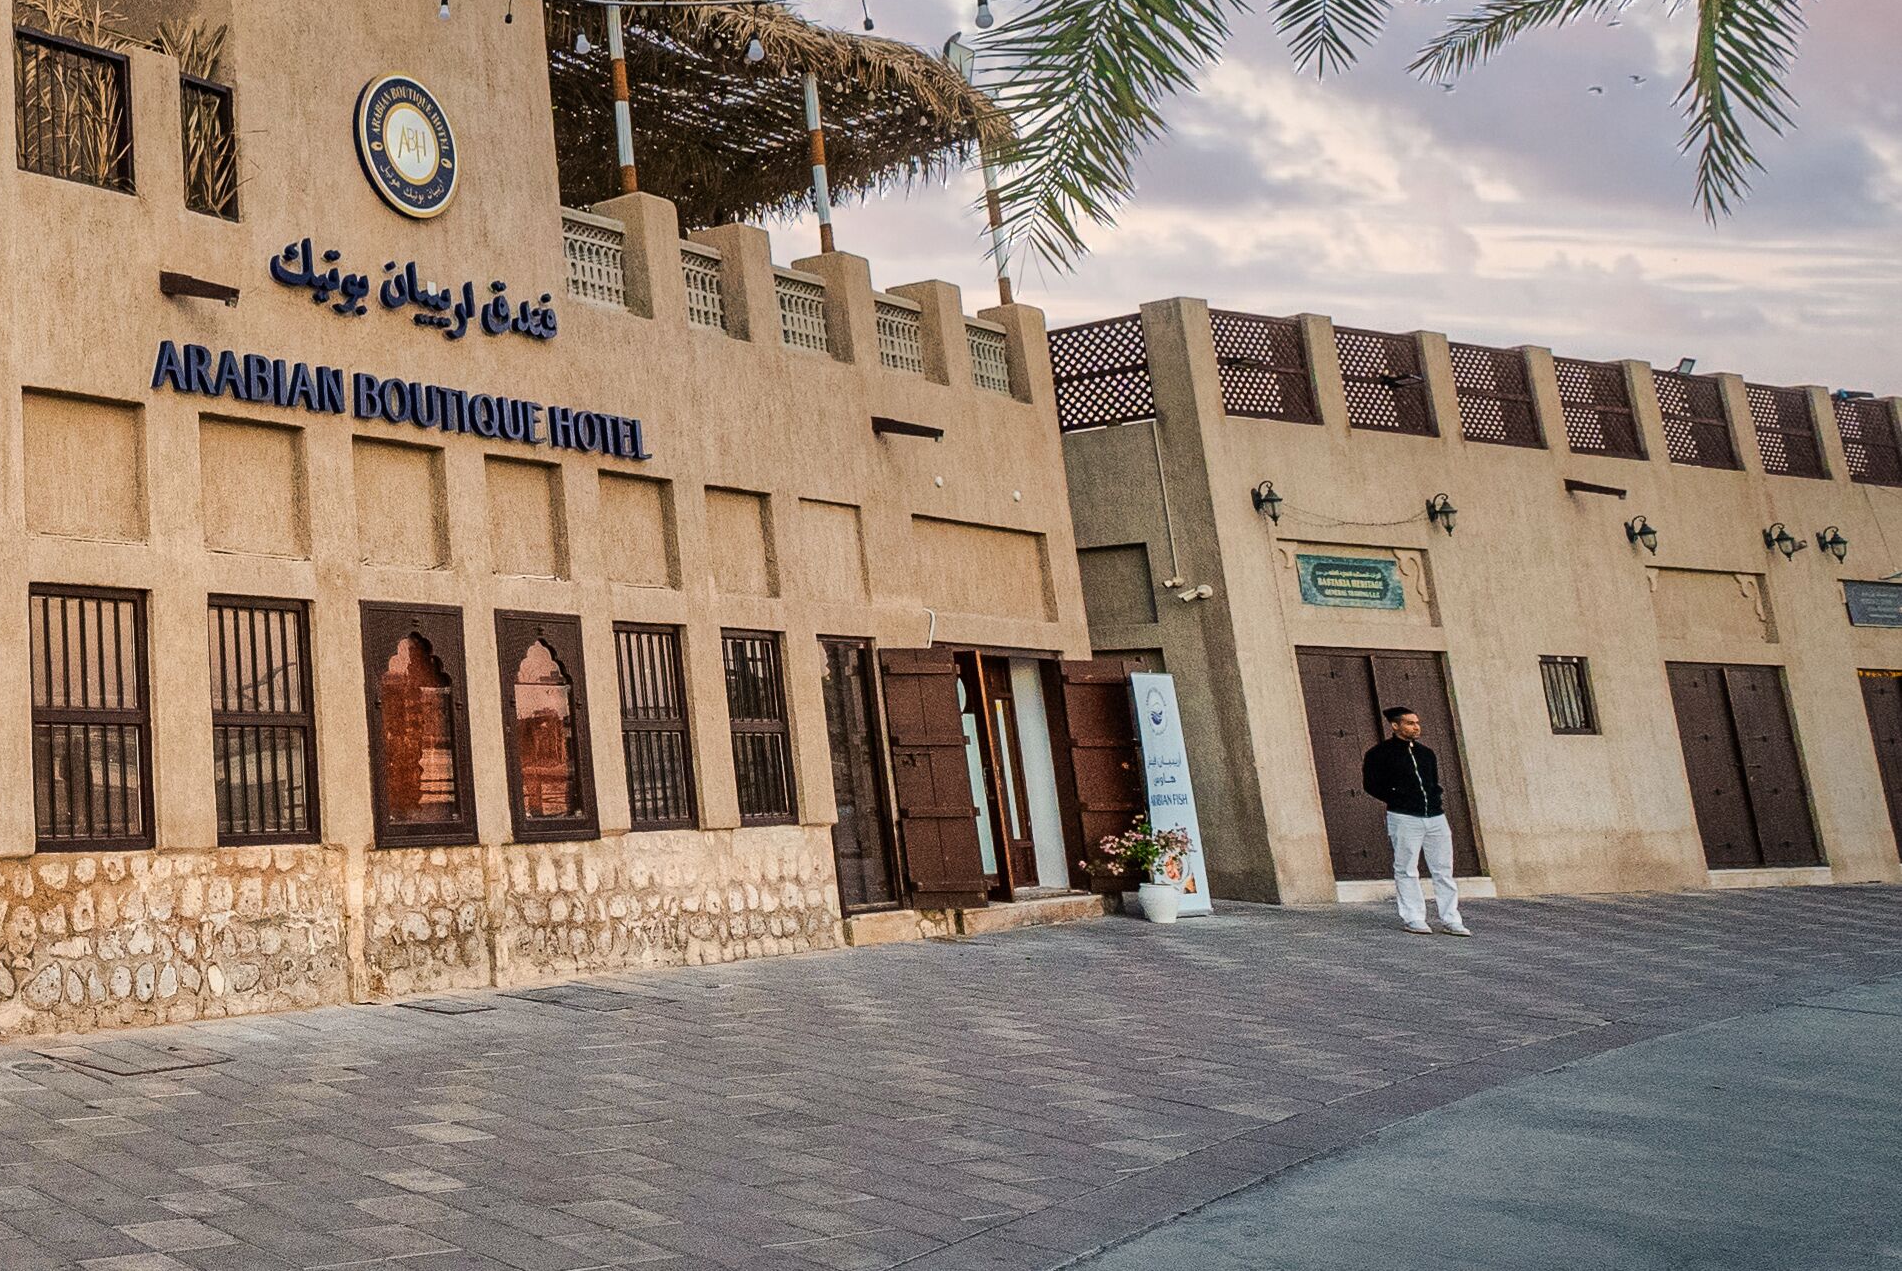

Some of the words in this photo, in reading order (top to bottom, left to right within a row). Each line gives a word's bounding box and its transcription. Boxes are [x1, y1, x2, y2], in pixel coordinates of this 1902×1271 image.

[372, 92, 392, 134] ARABIAN
[390, 86, 433, 113] BOUTIQUE
[431, 113, 449, 151] HOTEL
[269, 237, 370, 316] بوتيك
[480, 280, 558, 340] فندق
[150, 340, 346, 414] ARABIAN
[353, 372, 547, 445] BOUTIQUE
[547, 405, 653, 460] HOTEL
[1172, 793, 1188, 806] FISH
